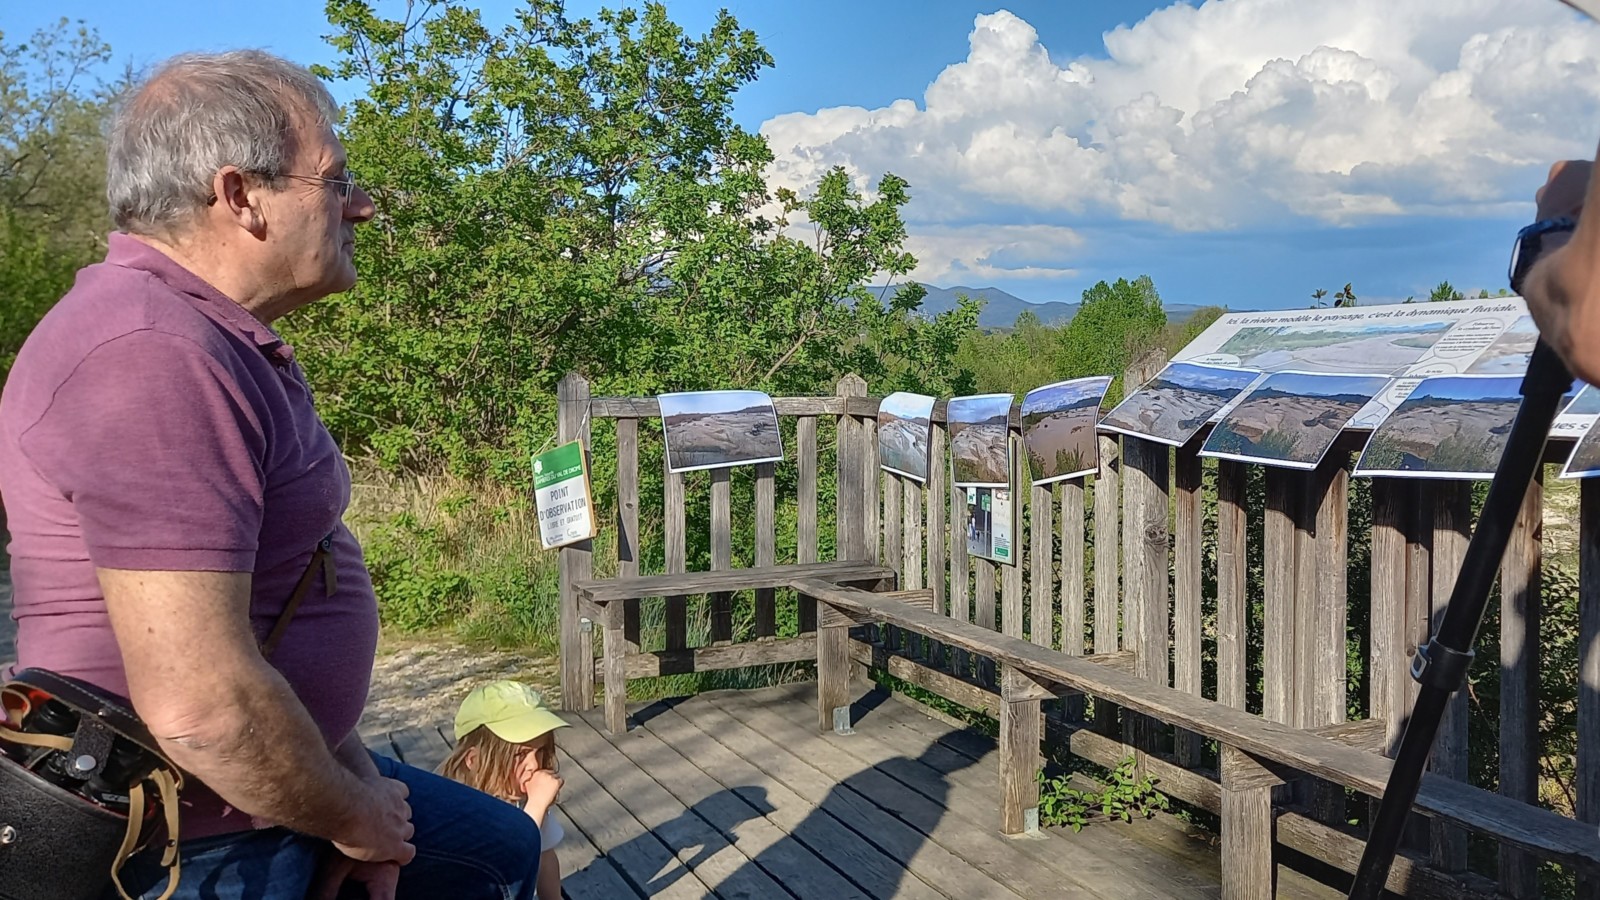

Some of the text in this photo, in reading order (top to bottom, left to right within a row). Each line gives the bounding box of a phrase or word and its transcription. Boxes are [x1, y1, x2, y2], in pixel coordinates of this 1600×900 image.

[1240, 317, 1249, 325] la
[1249, 315, 1278, 324] rivière
[1279, 314, 1312, 323] modèle
[1312, 314, 1322, 322] le
[1368, 310, 1394, 319] c'est
[1393, 308, 1405, 318] la
[1406, 306, 1470, 318] dynamique
[1470, 303, 1518, 314] fluviale.
[550, 486, 569, 501] POINT
[539, 497, 586, 521] D'OBSERVATION
[560, 518, 565, 527] ET
